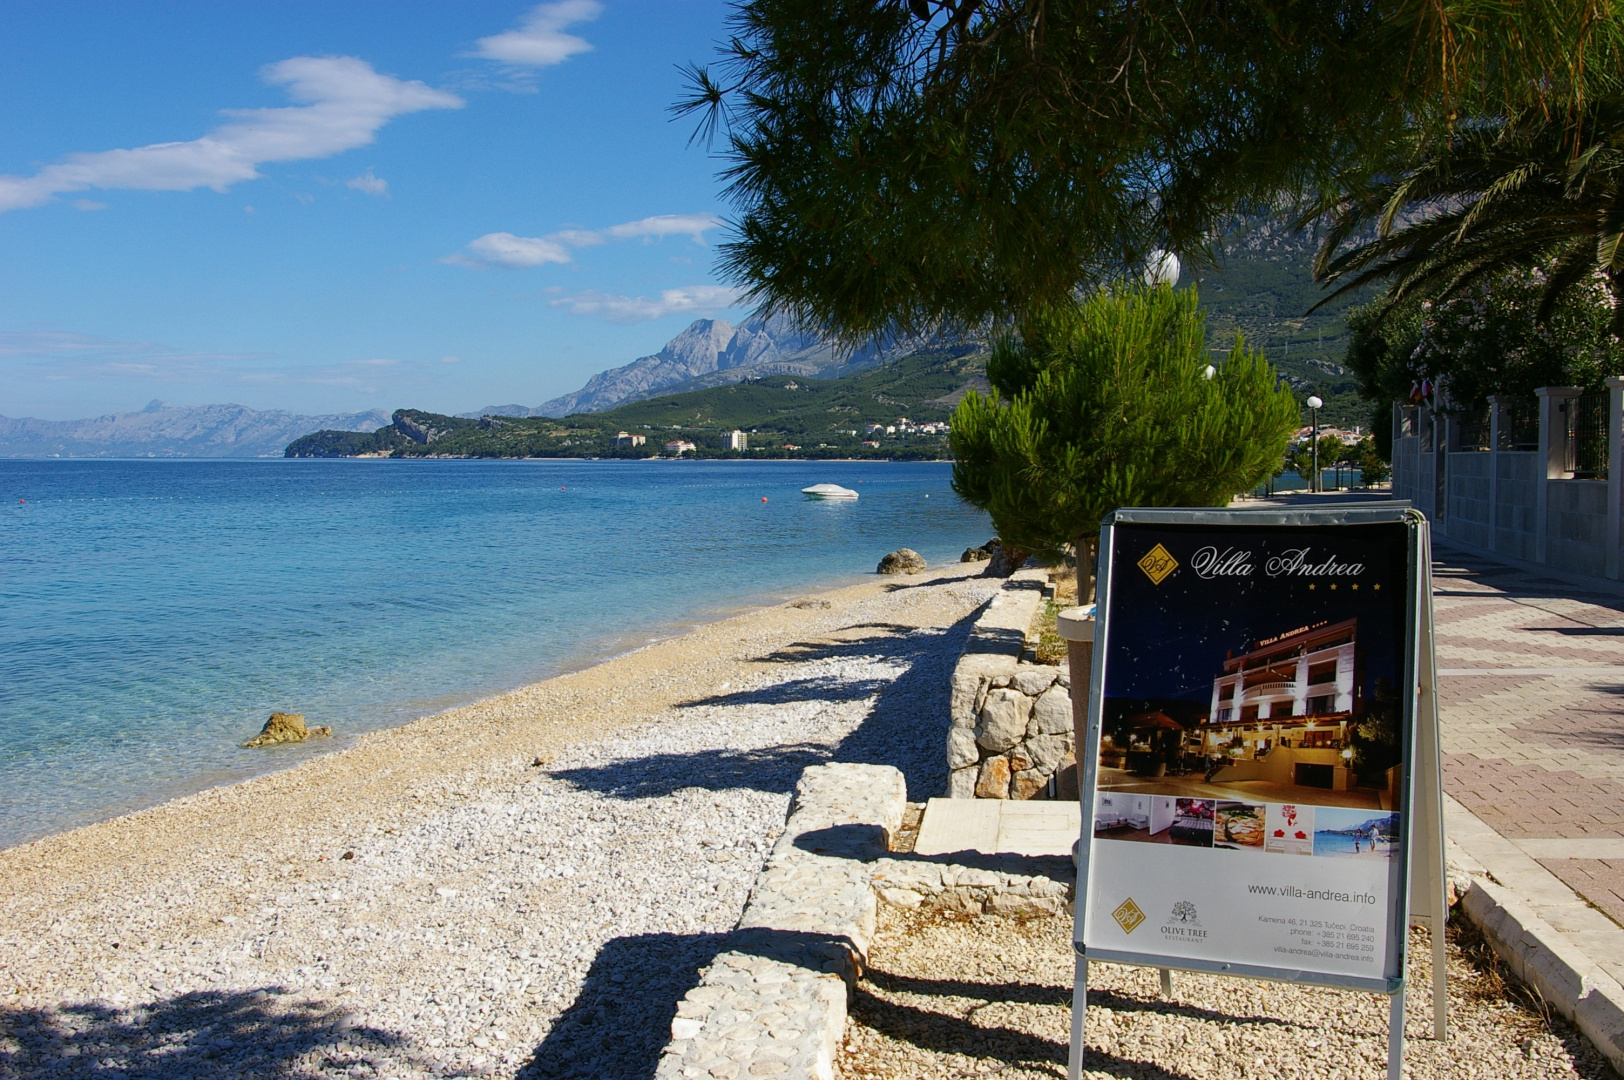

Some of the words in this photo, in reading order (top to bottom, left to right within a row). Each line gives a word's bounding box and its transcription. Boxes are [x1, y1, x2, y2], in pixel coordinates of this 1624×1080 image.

[1191, 545, 1256, 579] Villa
[1265, 547, 1366, 576] Andrea
[1259, 636, 1279, 646] VILLA
[1279, 625, 1309, 640] ANDREA
[1247, 884, 1376, 905] www.villa-andrea.info
[1160, 926, 1185, 936] OLIVE
[1188, 928, 1208, 938] TREE
[1258, 915, 1286, 925] Kamena
[1309, 920, 1323, 928] 325
[1349, 924, 1375, 933] Croatia
[1164, 936, 1204, 944] RESTAURANT
[1290, 928, 1313, 937] phone:
[1316, 931, 1335, 939] +385
[1336, 932, 1345, 940] 21
[1346, 933, 1360, 941] 695
[1361, 934, 1375, 943] 240
[1273, 946, 1374, 962] villa-andrea@villa-andrea.info
[1316, 940, 1335, 948] +385
[1336, 941, 1345, 949] 21
[1346, 942, 1360, 951] 695
[1361, 943, 1375, 952] 259
